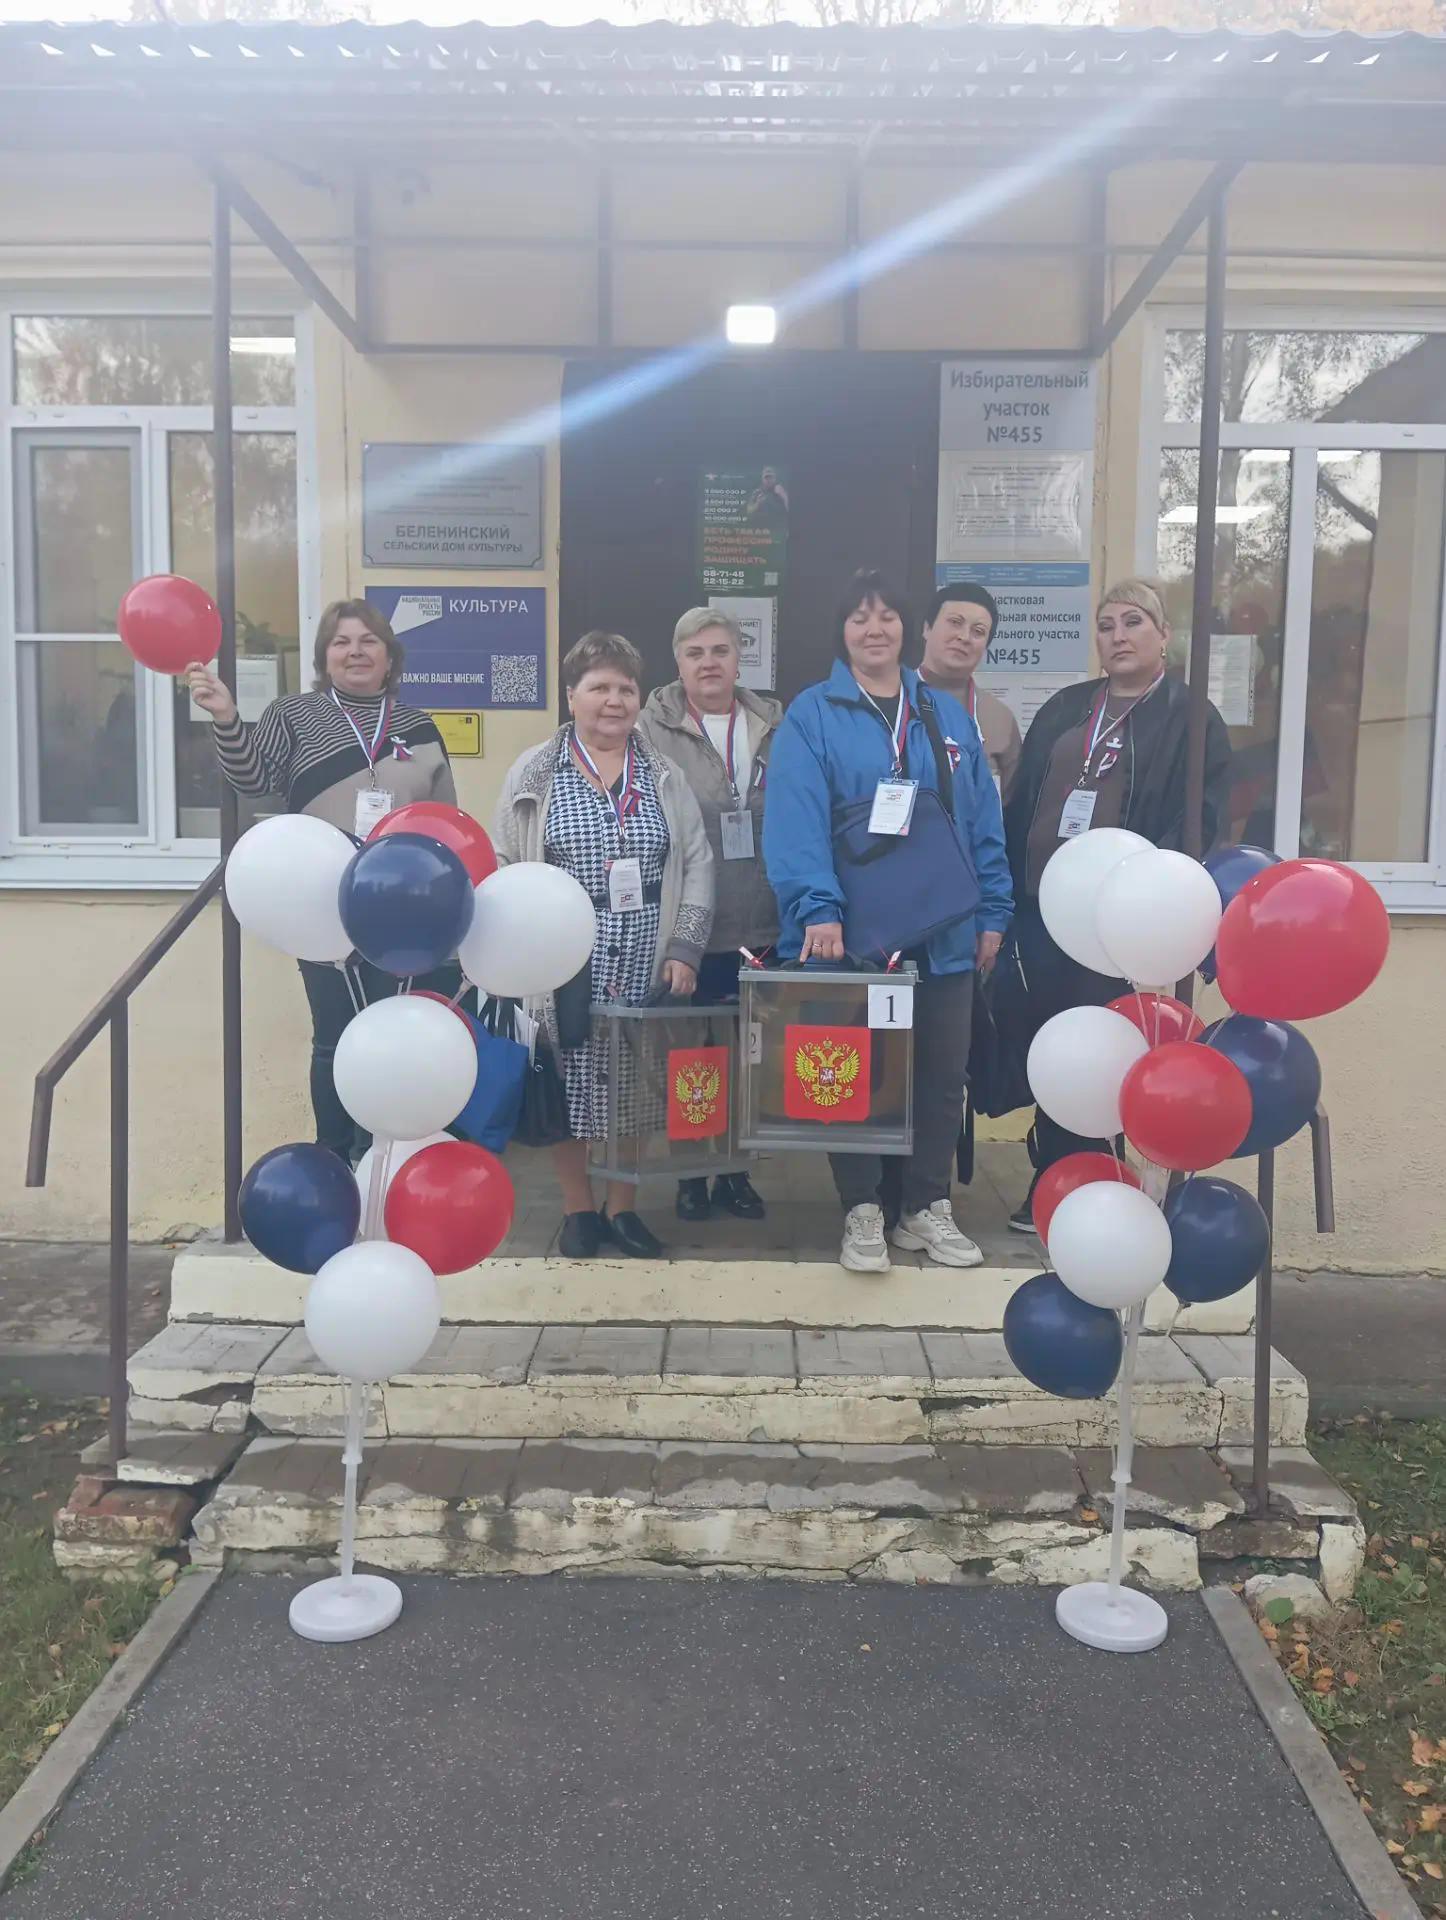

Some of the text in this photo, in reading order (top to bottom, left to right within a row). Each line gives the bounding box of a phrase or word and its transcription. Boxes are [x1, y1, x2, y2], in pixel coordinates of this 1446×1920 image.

[951, 370, 1088, 392] Избирательный
[983, 402, 1050, 421] участок
[986, 426, 1043, 443] №455
[396, 524, 510, 540] БЕЛЕНИНСКИЙ
[383, 540, 523, 553] СЕЛЬСКИЙ ДОМ КУЛЬТУРЫ
[449, 599, 529, 613] КУЛЬТУРА
[994, 596, 1045, 605] астковая
[1030, 613, 1081, 623] комиссия
[1038, 630, 1080, 642] участка
[986, 648, 1041, 665] №455
[402, 673, 430, 684] ВАЖНО
[430, 673, 453, 684] ВАШЕ
[453, 673, 485, 684] МНЕНИЕ
[885, 994, 897, 1023] 1
